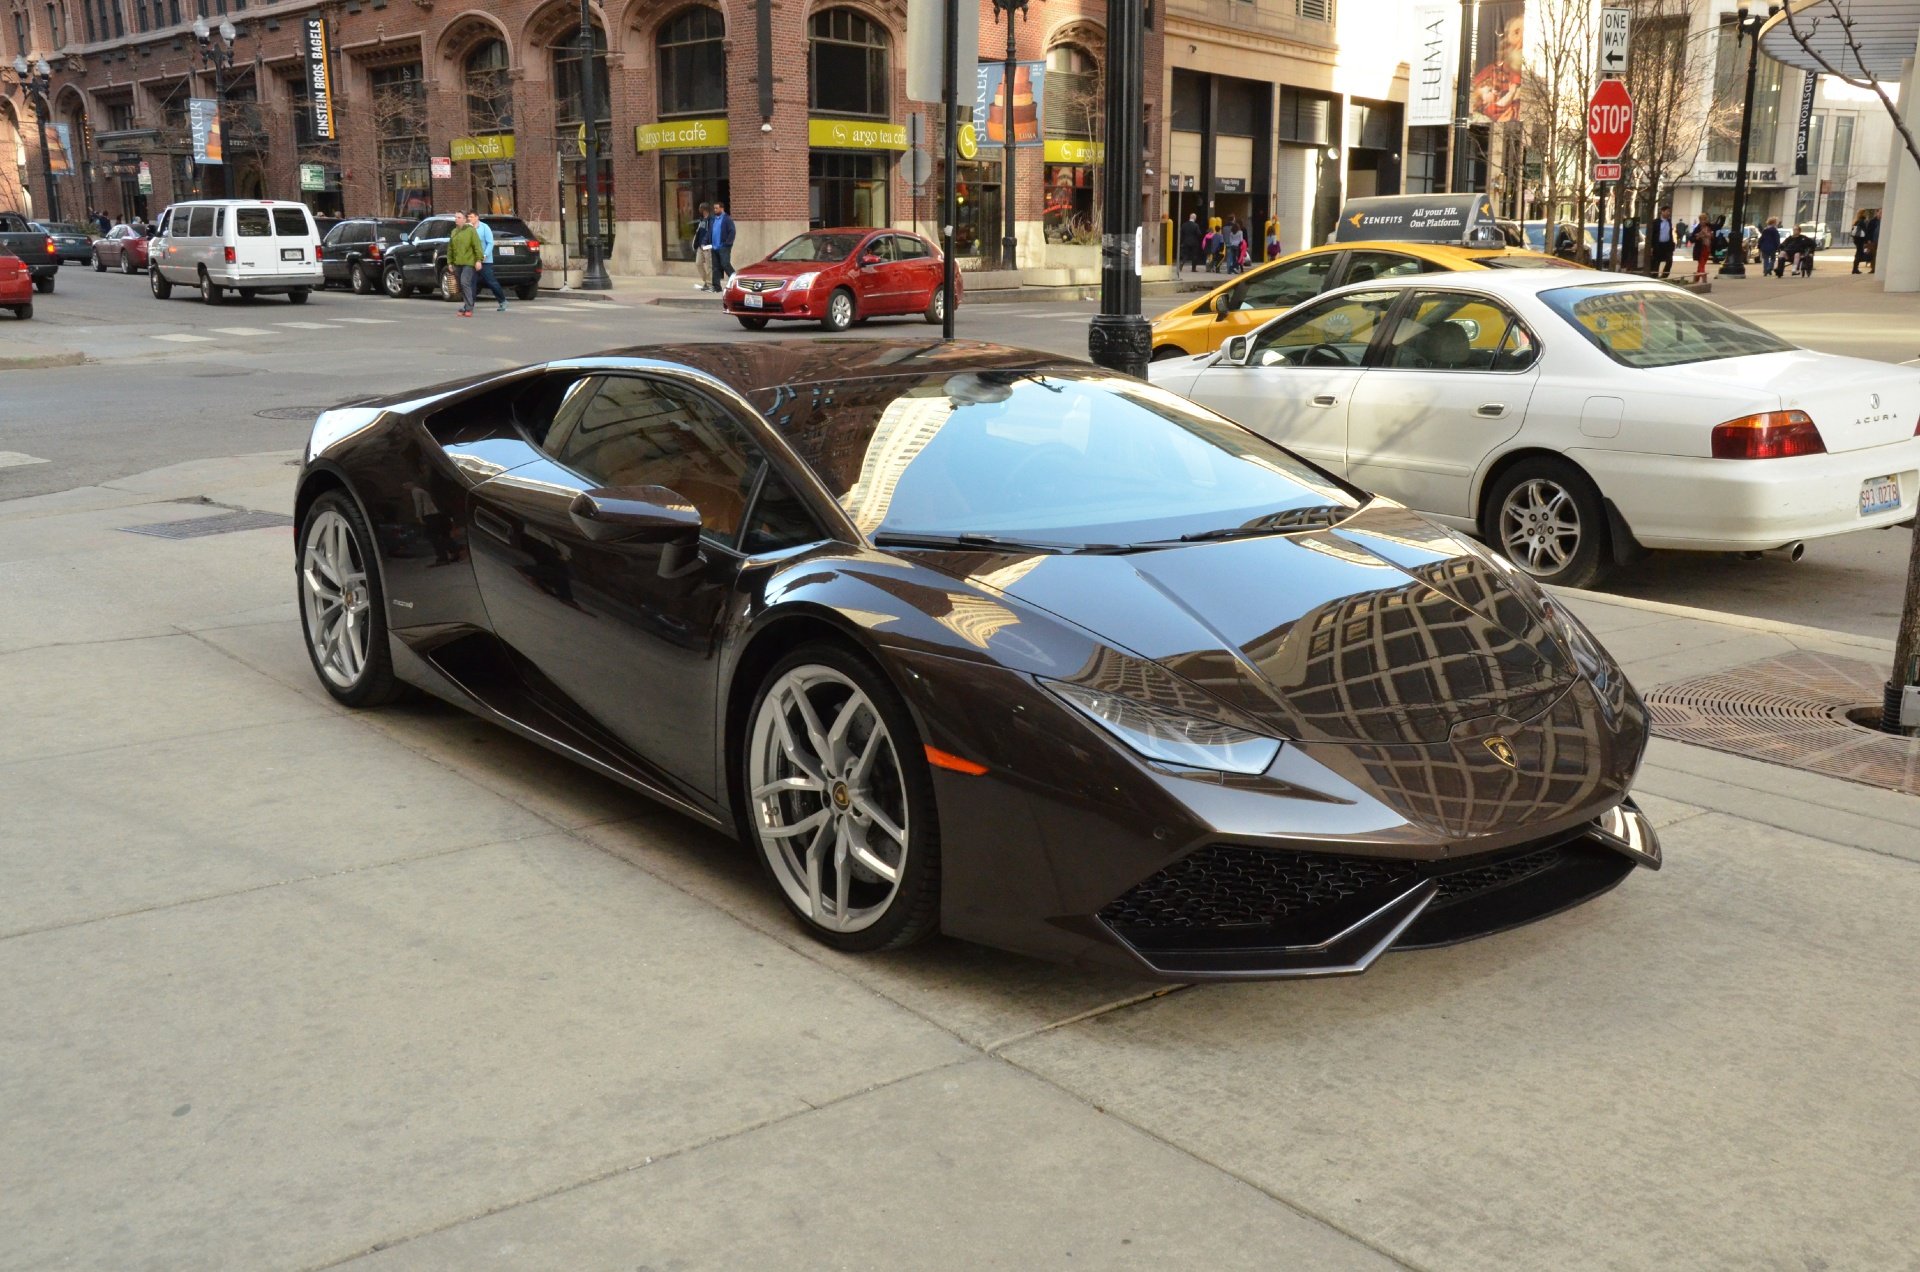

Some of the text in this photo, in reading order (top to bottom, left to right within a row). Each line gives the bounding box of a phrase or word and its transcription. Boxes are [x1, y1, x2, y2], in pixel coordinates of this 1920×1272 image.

[1605, 14, 1627, 29] ONE
[1604, 31, 1626, 47] WAY
[1422, 19, 1444, 100] LUMA
[309, 20, 330, 137] EINSTEIN BROS. BAGELS
[973, 66, 989, 142] SHAKER
[1590, 105, 1631, 135] STOP
[1796, 70, 1815, 159] ORDSTROM rack
[190, 101, 206, 160] SHAKER
[661, 129, 676, 142] tea
[678, 122, 707, 142] café
[852, 130, 877, 146] argo
[879, 129, 892, 144] tea
[478, 137, 499, 154] café
[1597, 167, 1618, 177] ALL WAY
[1363, 215, 1403, 225] ZENEFITS
[1412, 207, 1458, 218] All your HR.
[1410, 218, 1462, 228] One Platform.
[1855, 413, 1898, 425] ACURA
